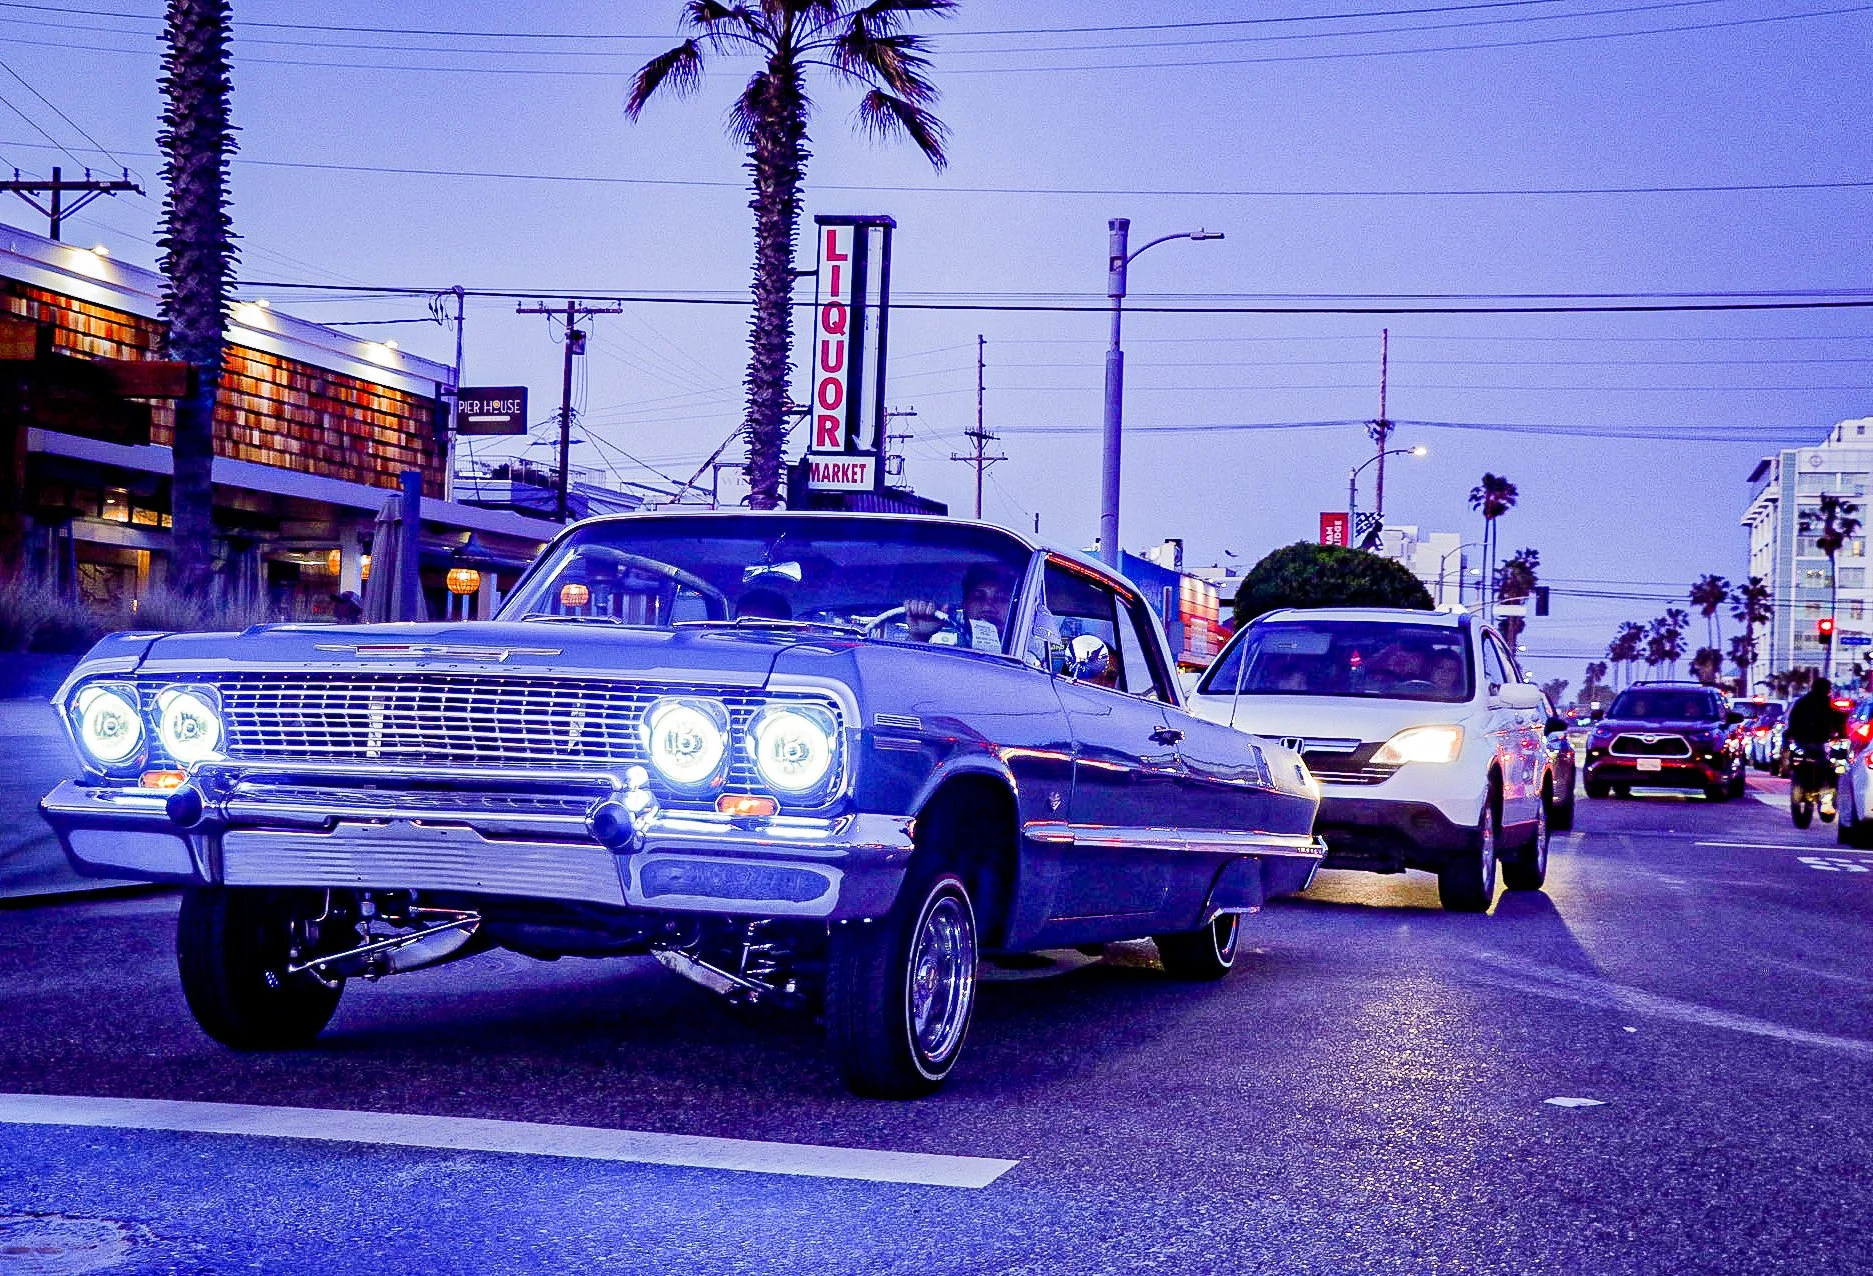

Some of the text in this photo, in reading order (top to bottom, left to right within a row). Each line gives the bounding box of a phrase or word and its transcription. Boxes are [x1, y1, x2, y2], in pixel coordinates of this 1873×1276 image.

[816, 229, 848, 447] LIQUOR
[458, 400, 521, 414] PIER HOUSE
[809, 462, 867, 483] MARKET
